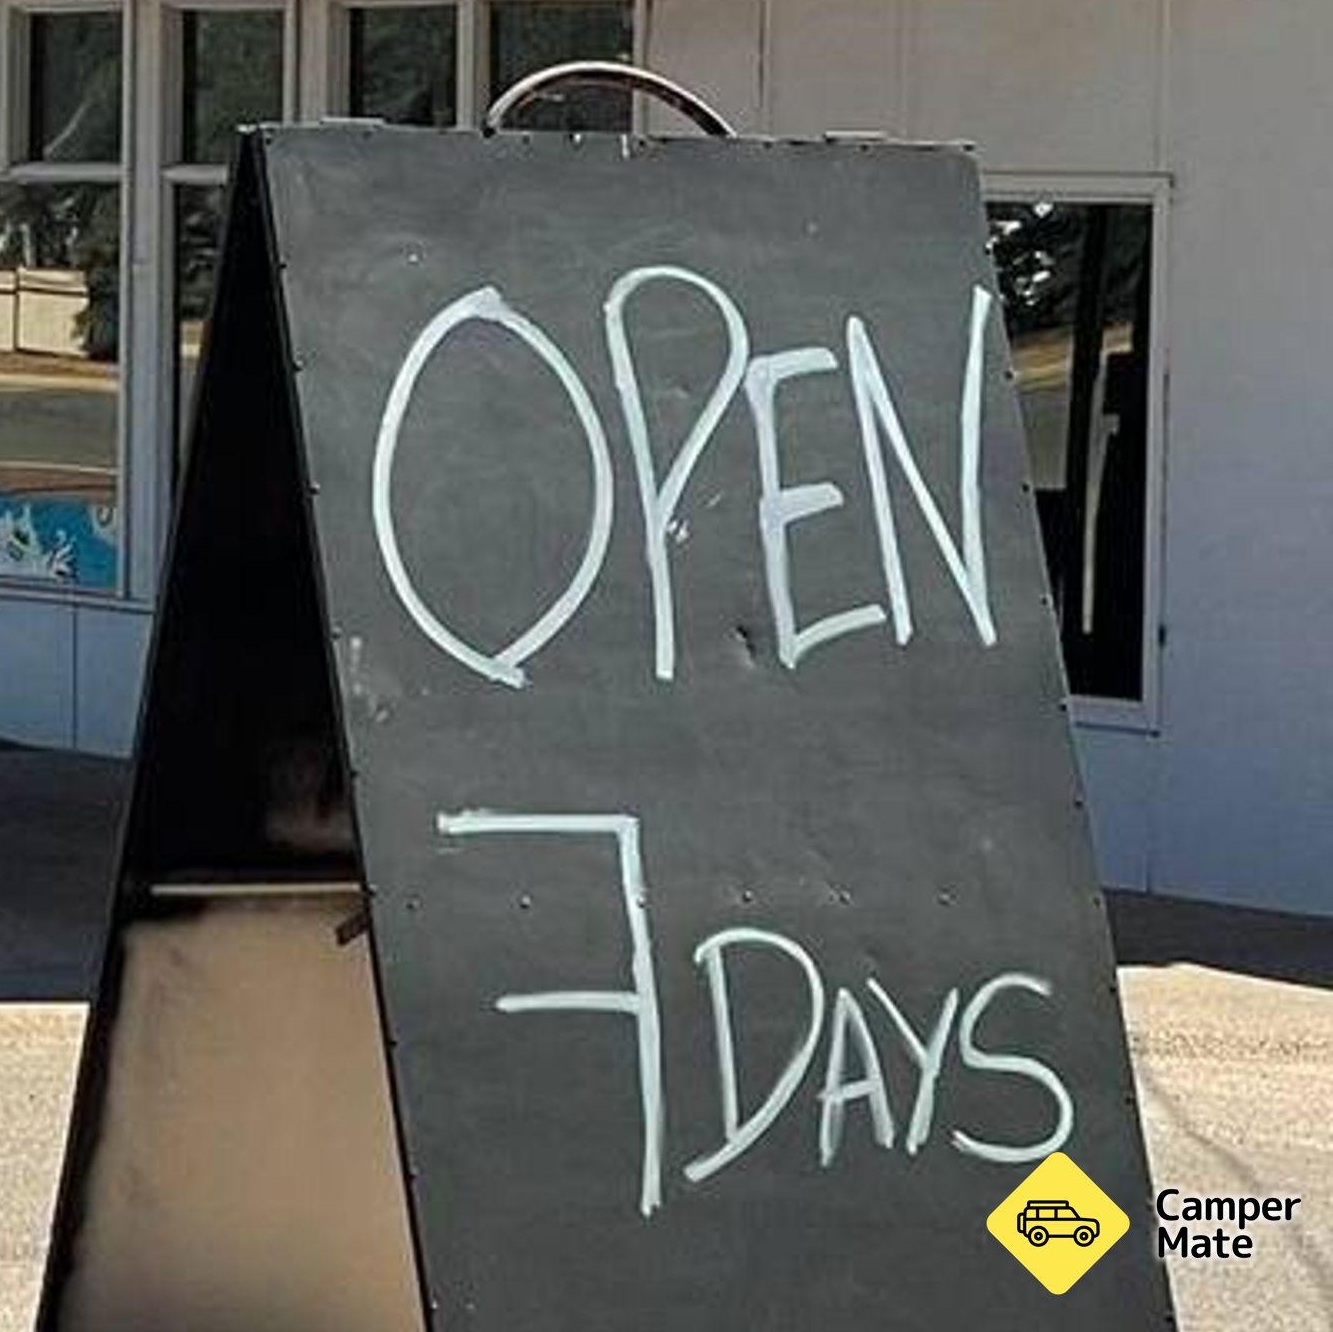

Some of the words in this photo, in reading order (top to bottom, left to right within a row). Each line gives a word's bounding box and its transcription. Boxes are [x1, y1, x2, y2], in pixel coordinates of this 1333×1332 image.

[371, 264, 998, 689] OPEN
[437, 808, 664, 1217] 7
[683, 926, 1075, 1183] DAYS
